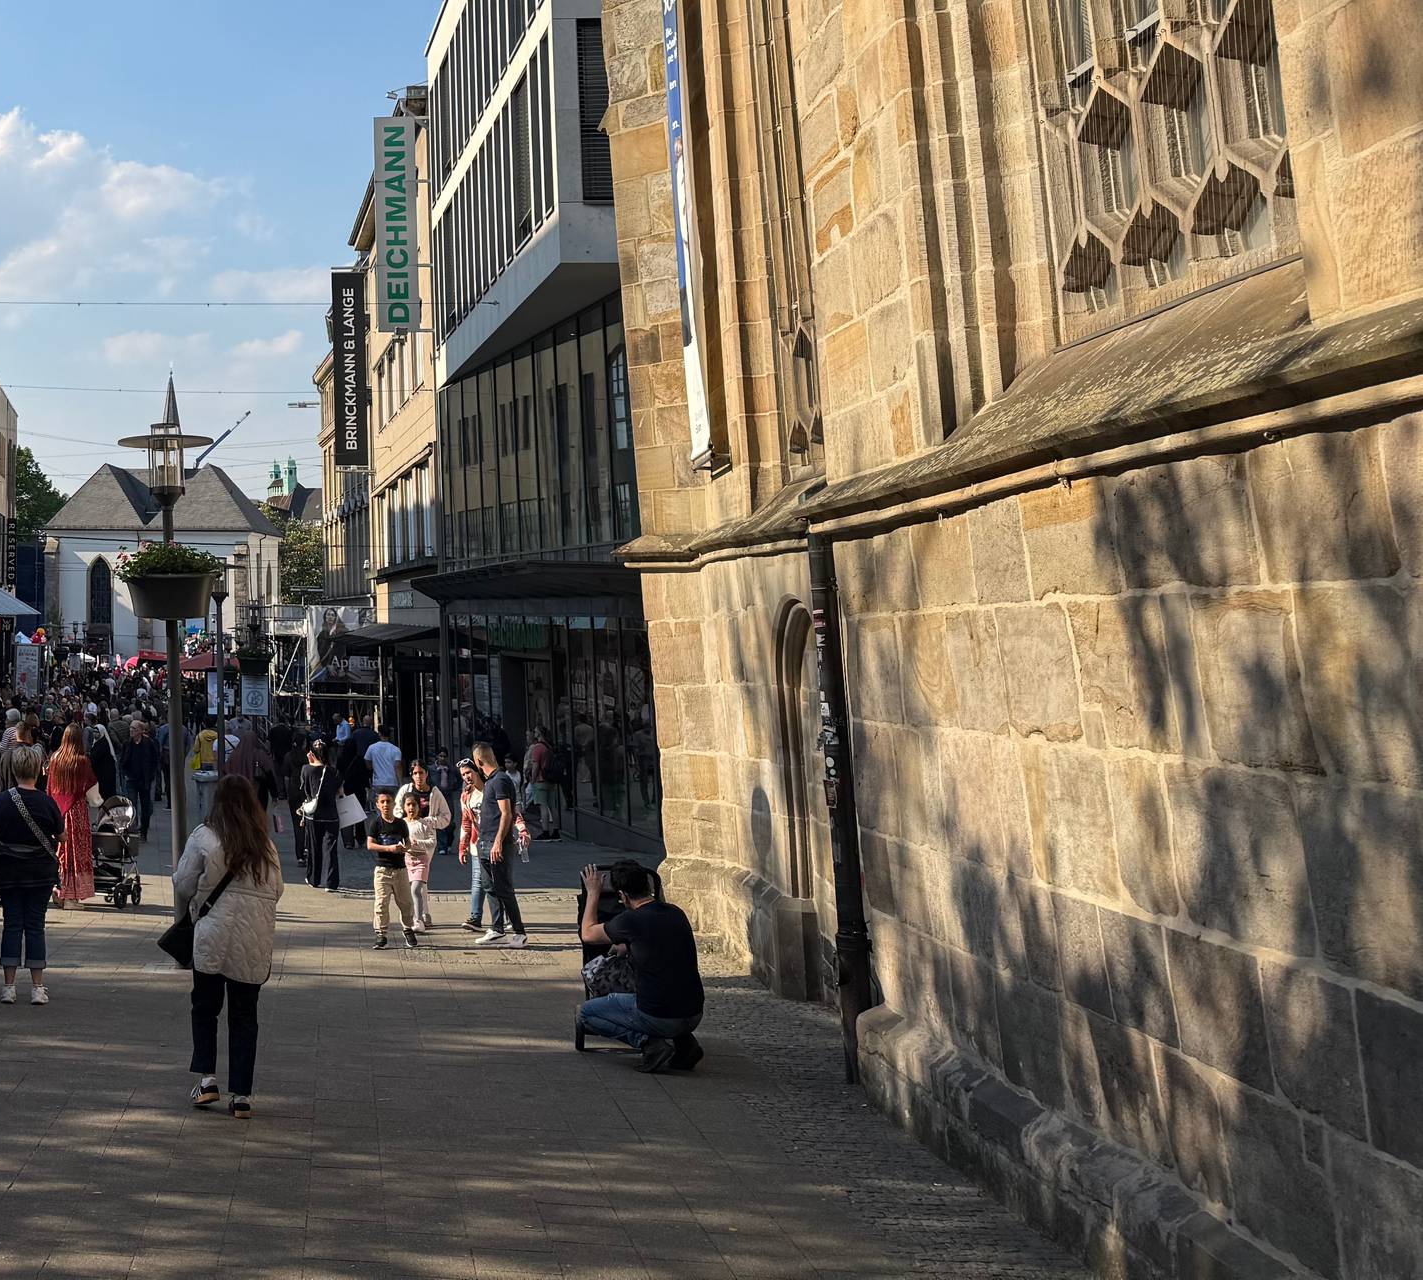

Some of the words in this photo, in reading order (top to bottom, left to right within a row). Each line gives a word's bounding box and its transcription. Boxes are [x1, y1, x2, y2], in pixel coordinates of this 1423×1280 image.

[383, 125, 410, 324] DEICHMANN
[344, 288, 355, 337] LANGE
[344, 340, 355, 351] &
[345, 357, 357, 451] BRINCKMANN
[8, 523, 16, 580] RESERVED
